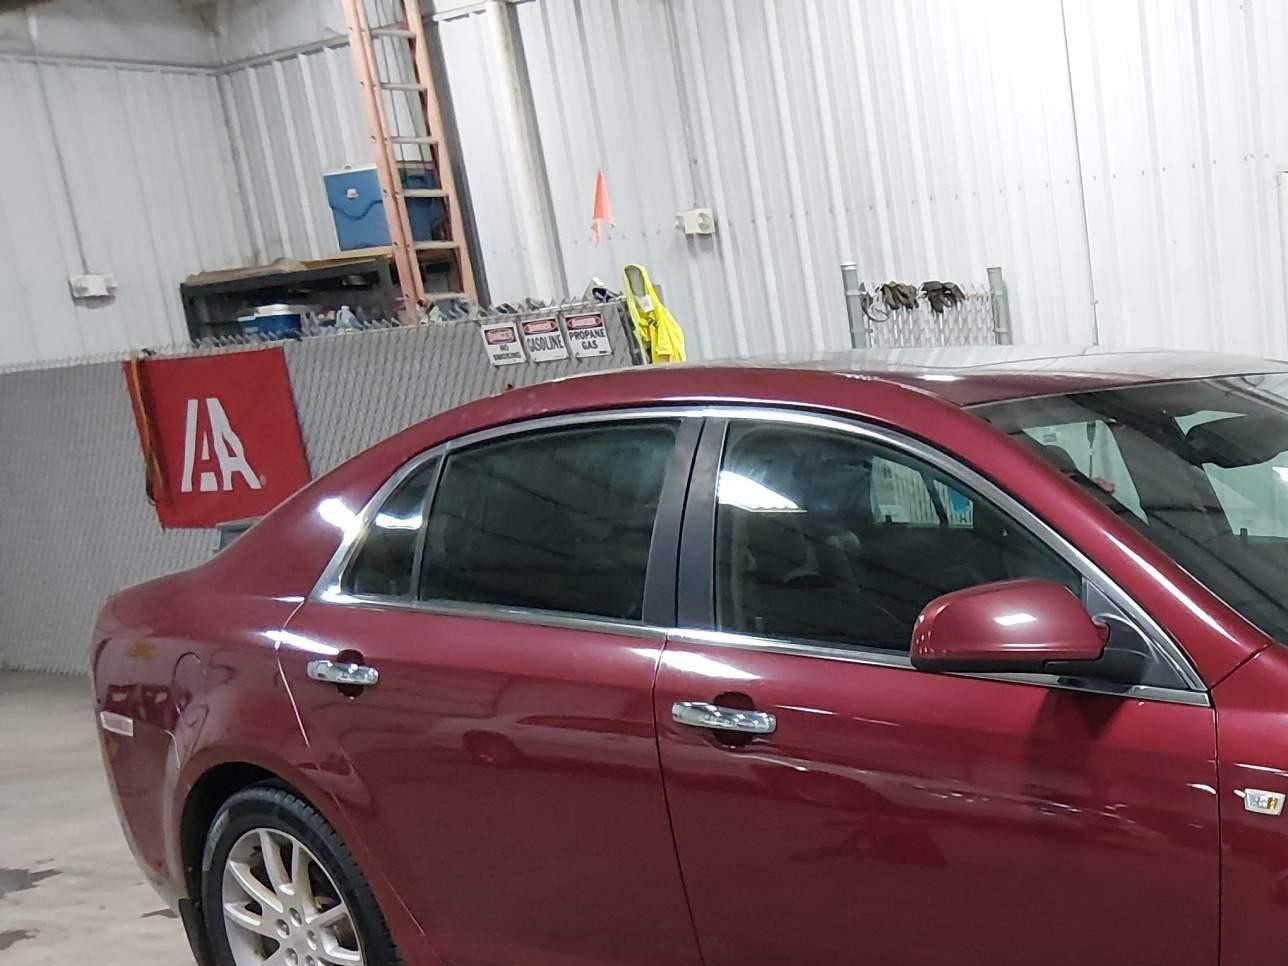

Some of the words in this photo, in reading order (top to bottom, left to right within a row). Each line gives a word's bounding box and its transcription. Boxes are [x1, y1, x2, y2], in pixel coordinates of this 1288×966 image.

[569, 329, 606, 340] PROPANE
[528, 334, 564, 352] GASOLINE
[581, 341, 598, 350] GAS
